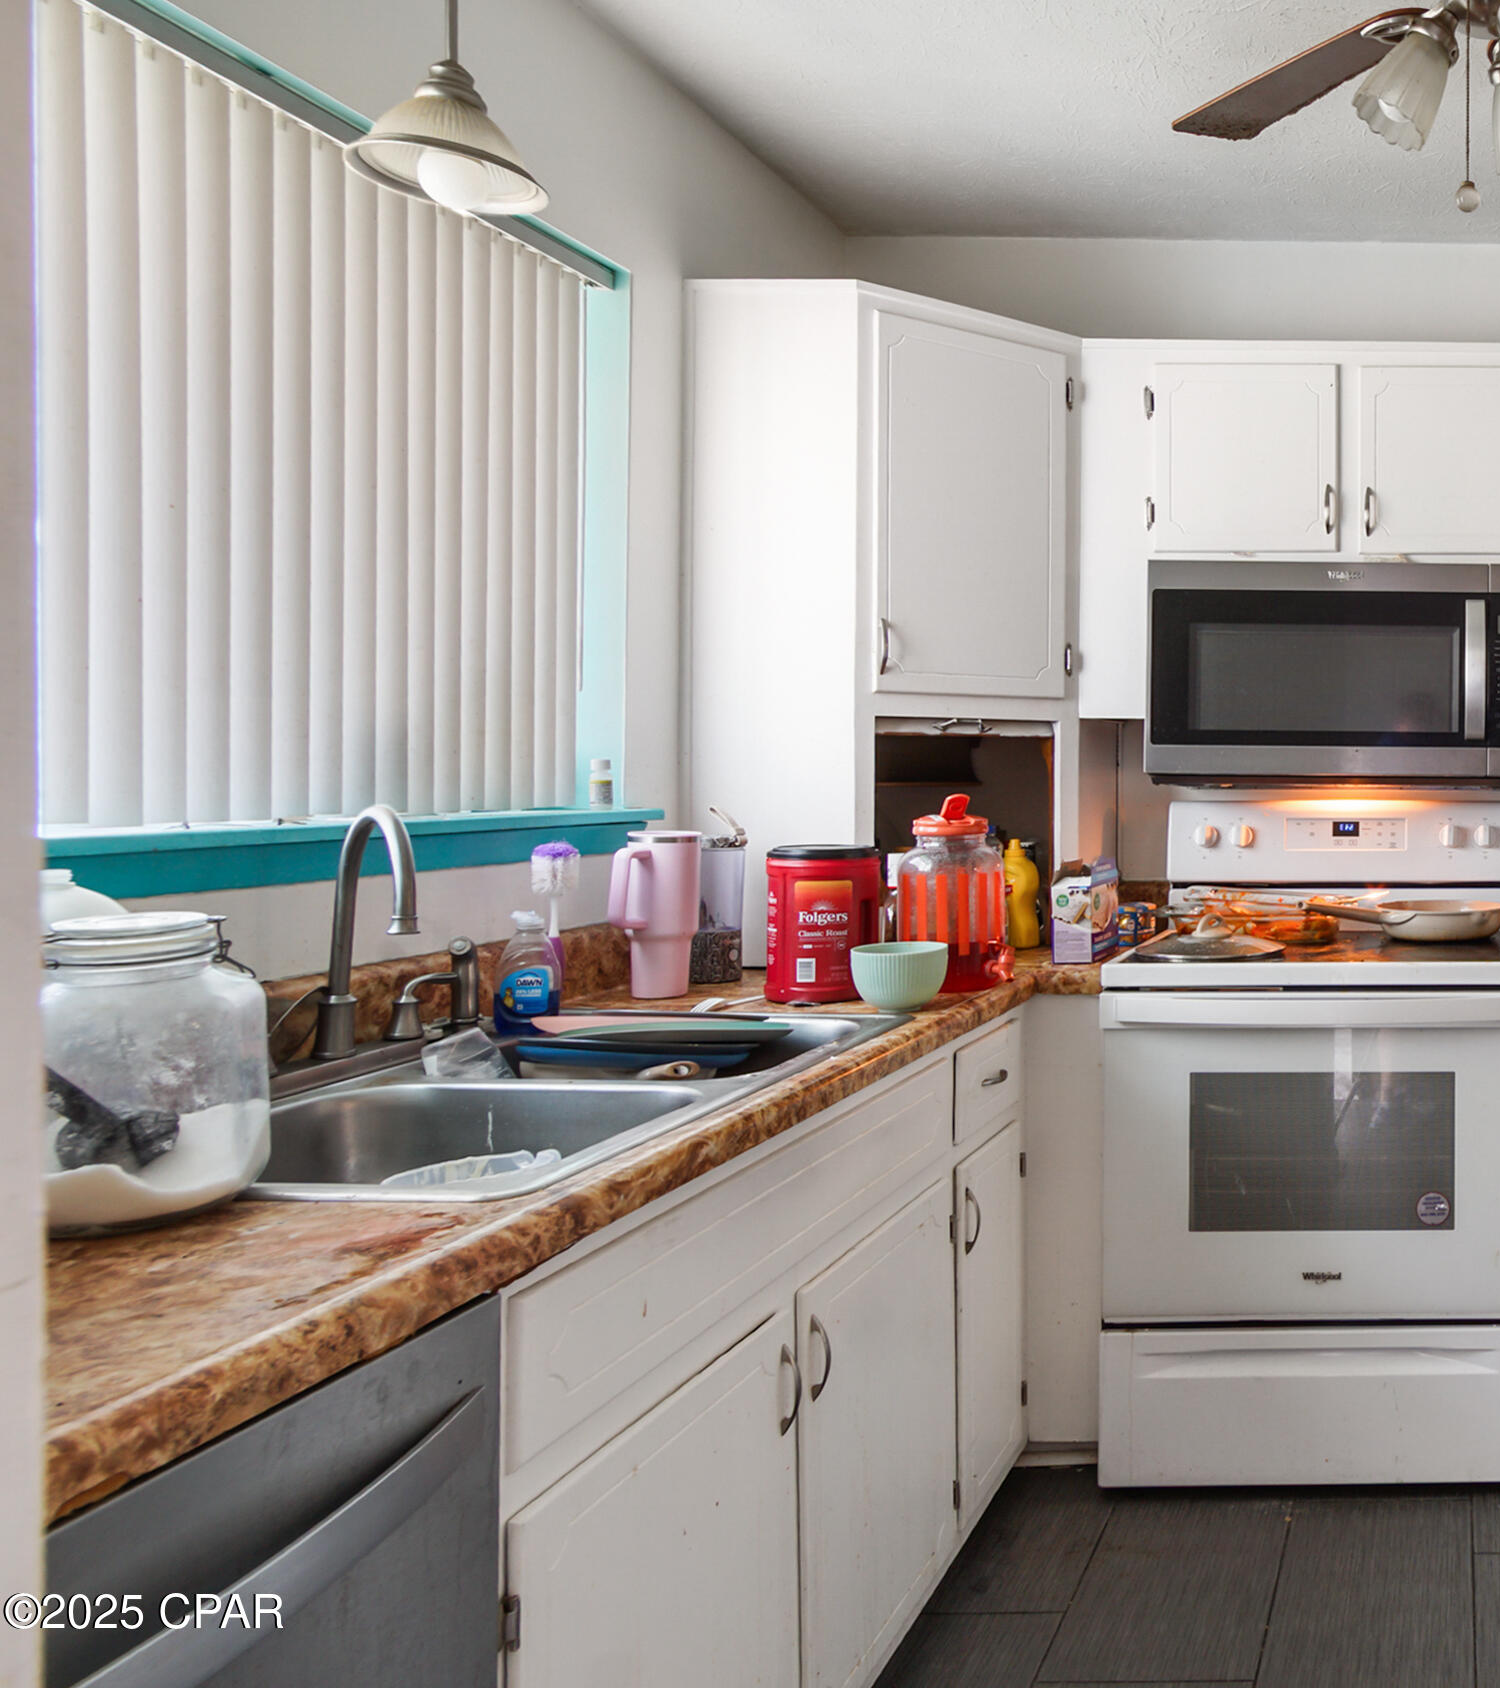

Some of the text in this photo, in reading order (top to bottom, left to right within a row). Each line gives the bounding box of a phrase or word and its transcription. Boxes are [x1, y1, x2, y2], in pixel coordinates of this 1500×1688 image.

[798, 911, 849, 926] Folgers
[797, 929, 849, 938] Classic Roast
[515, 978, 543, 987] DAWN
